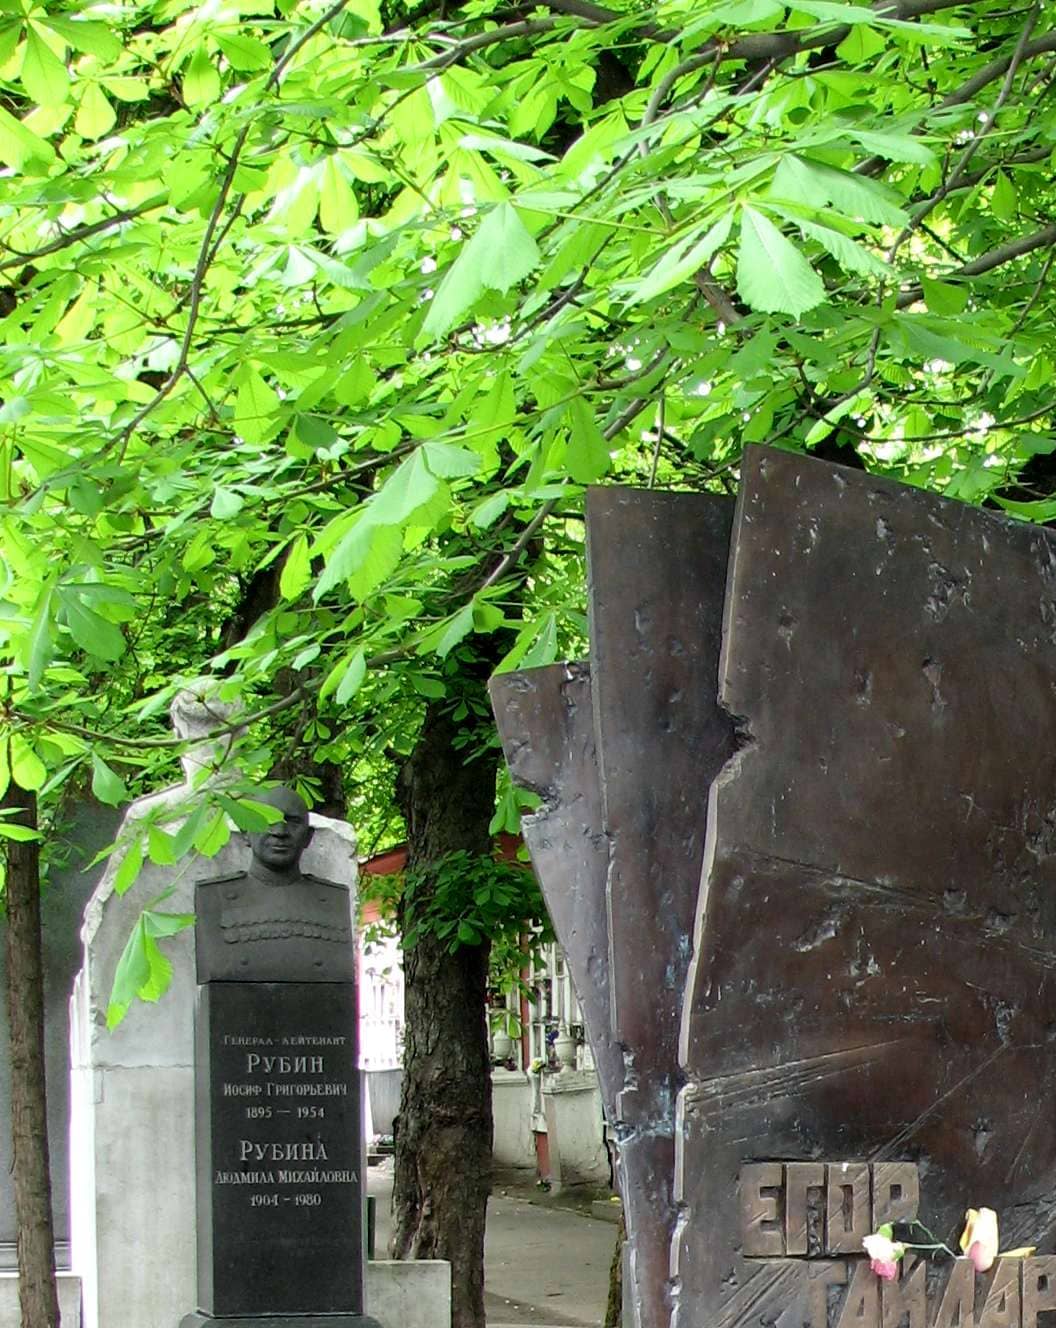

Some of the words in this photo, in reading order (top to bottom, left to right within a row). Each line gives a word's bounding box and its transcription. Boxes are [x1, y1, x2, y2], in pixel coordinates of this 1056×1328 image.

[247, 1053, 325, 1073] РУБИН
[223, 1083, 262, 1096] ИОСИФ
[267, 1082, 347, 1096] ГРИГОРЬЕВИЧ
[246, 1107, 272, 1118] 1895
[297, 1107, 325, 1118] 1954
[239, 1140, 328, 1160] РУБИНА
[215, 1171, 275, 1184] ЛЮДМИЛА
[278, 1168, 358, 1184] МИХАЙЛОВНА
[250, 1194, 278, 1206] 1904
[295, 1194, 321, 1206] 1980
[740, 1161, 919, 1257] ЕГОР
